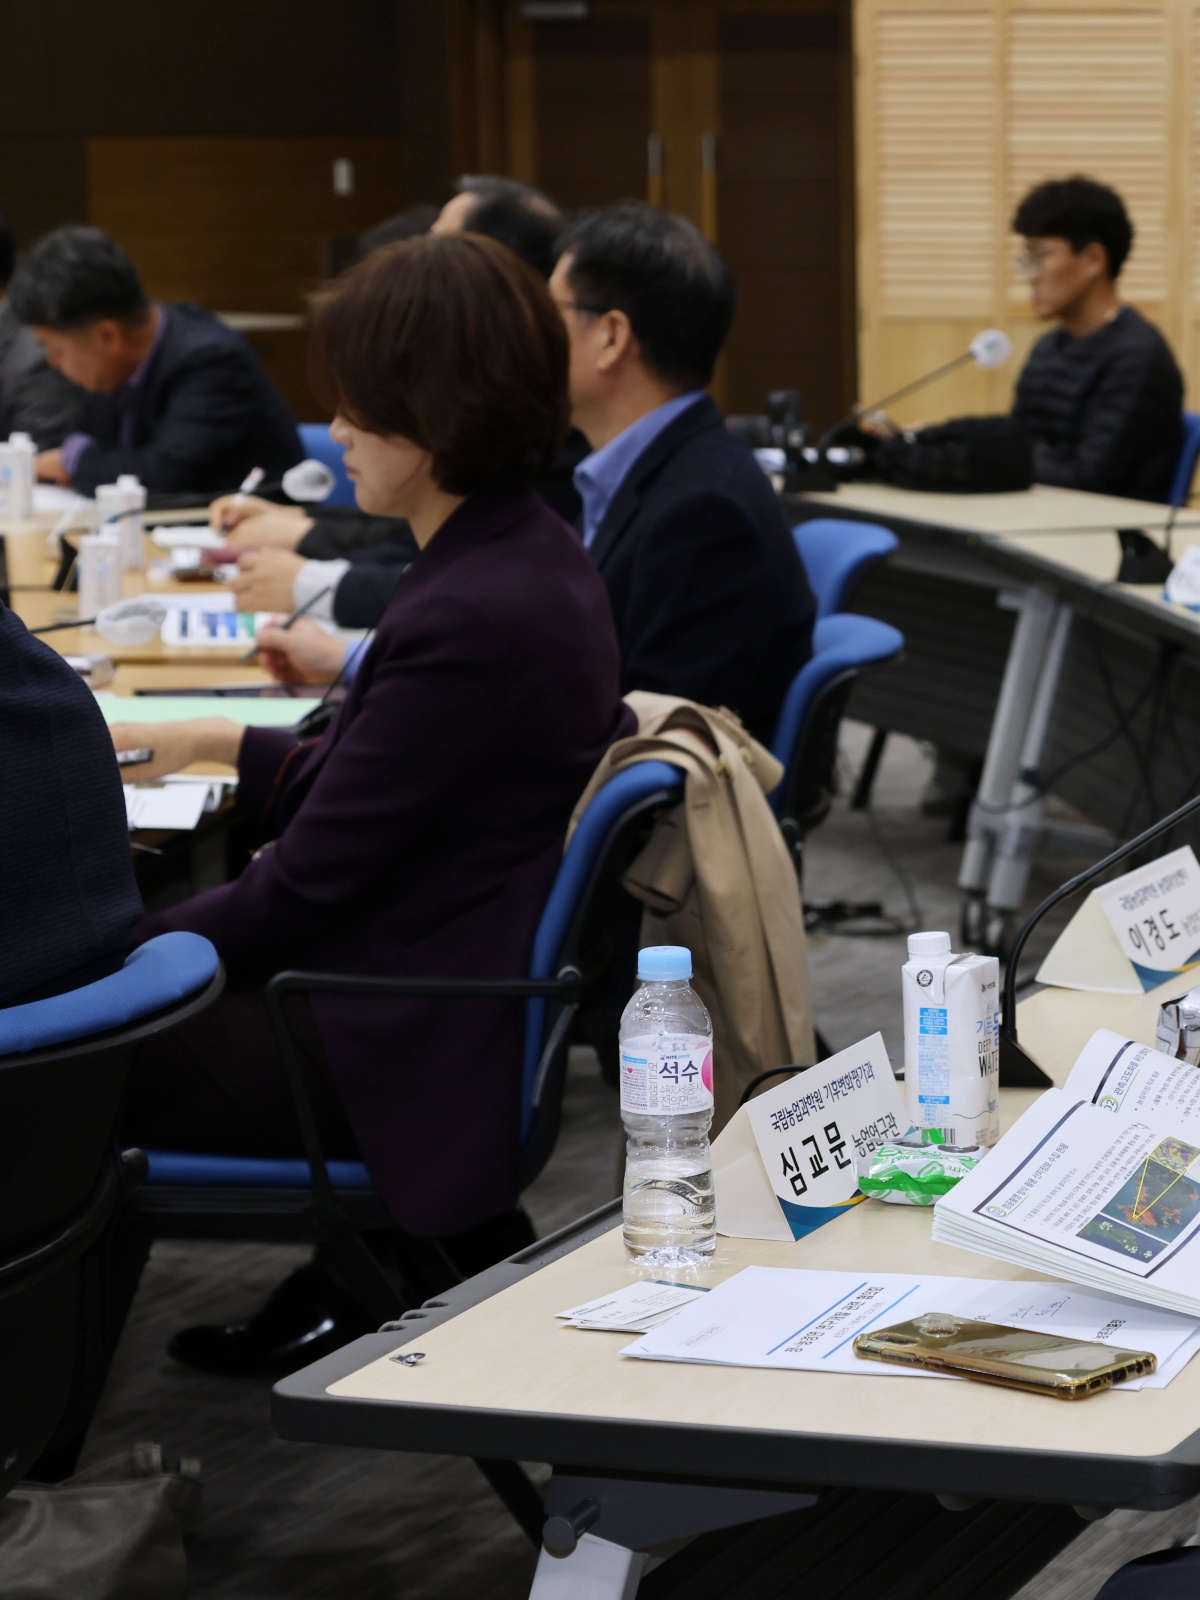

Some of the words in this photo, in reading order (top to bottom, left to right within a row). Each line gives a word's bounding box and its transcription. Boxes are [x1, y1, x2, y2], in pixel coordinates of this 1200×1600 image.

[659, 1060, 699, 1084] 석수
[770, 1089, 825, 1133] 국립농업과학원
[823, 1061, 876, 1102] 기후변화평가과
[1113, 1061, 1138, 1095] 관측고도화를
[780, 1121, 852, 1197] 심교문
[852, 1112, 901, 1157] 농업연구관
[1001, 1193, 1022, 1209] 항공촬영
[1016, 1185, 1030, 1196] 방식
[1023, 1177, 1037, 1188] 활용
[1032, 1161, 1052, 1179] 산지정보
[1048, 1151, 1061, 1162] 수집
[1055, 1142, 1069, 1153] 현황
[815, 1311, 851, 1329] 연구개발
[841, 1301, 865, 1310] 관련
[856, 1286, 884, 1299] 협의회
